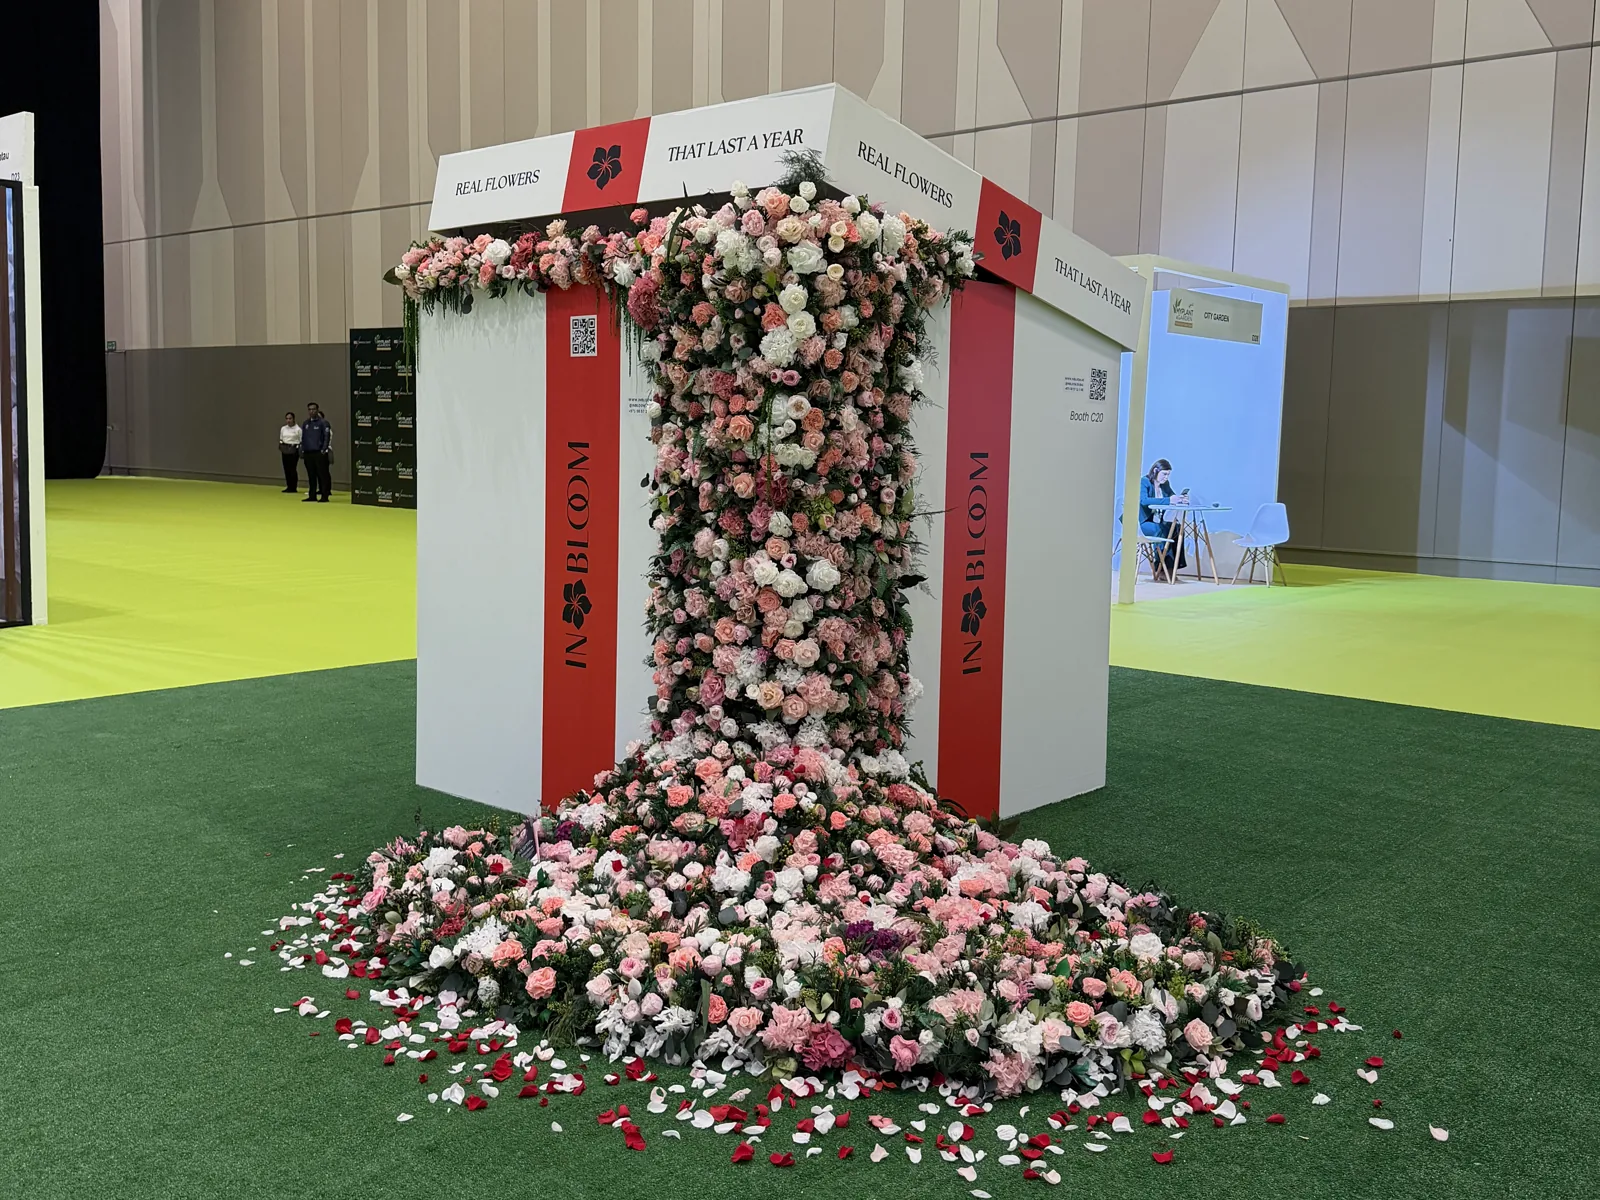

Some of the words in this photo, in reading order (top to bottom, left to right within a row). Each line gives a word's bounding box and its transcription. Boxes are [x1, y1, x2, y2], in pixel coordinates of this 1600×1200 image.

[668, 142, 706, 162] THAT
[707, 136, 746, 157] LAST
[747, 135, 758, 151] A
[762, 128, 803, 149] YEAR
[455, 179, 483, 196] REAL
[484, 169, 541, 192] FLOWERS
[857, 140, 892, 175] REAL
[894, 162, 953, 209] FLOWERS
[1054, 257, 1079, 283] THAT
[1080, 272, 1102, 296] LAST
[1101, 287, 1108, 302] A
[1110, 290, 1131, 315] YEAR
[1203, 311, 1213, 320] CITY
[1213, 313, 1230, 323] GARDEN
[1070, 410, 1090, 422] Booth
[1090, 412, 1104, 423] C20
[566, 441, 590, 574] BLOOM
[965, 452, 989, 582] BLOOM
[565, 632, 588, 669] IN
[962, 640, 983, 675] IN
